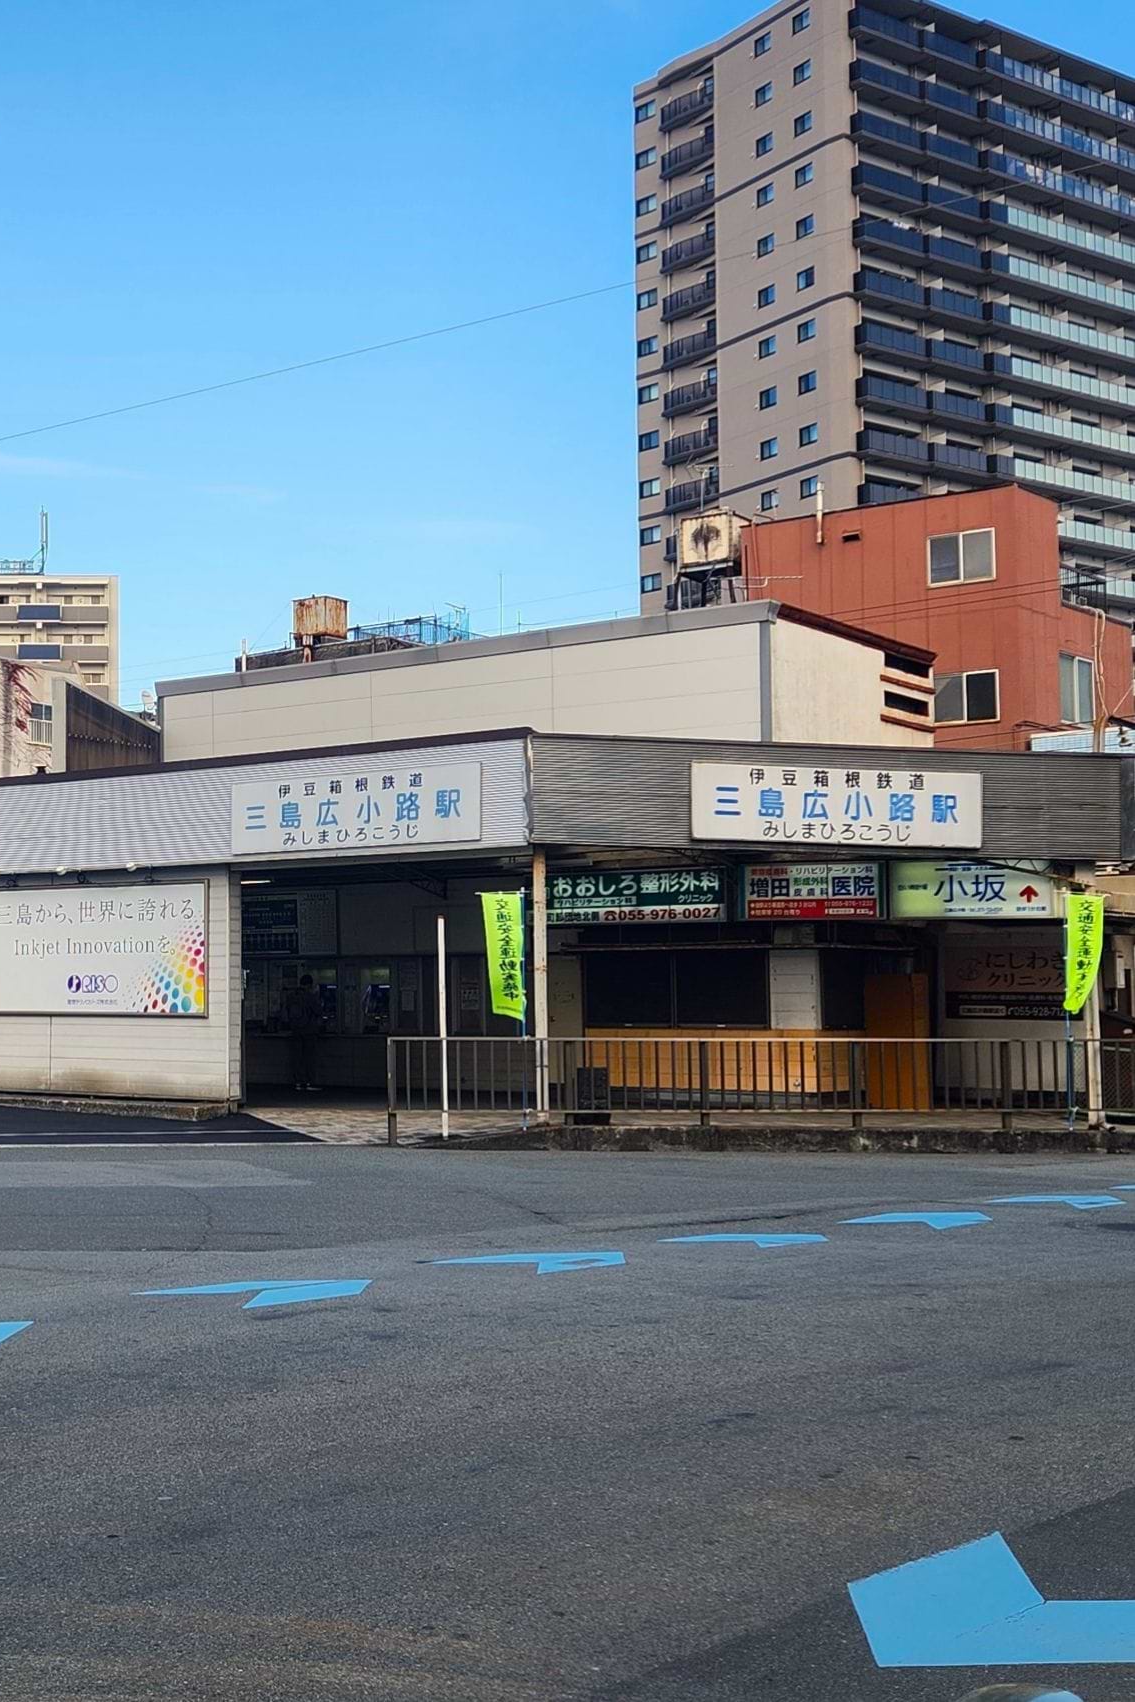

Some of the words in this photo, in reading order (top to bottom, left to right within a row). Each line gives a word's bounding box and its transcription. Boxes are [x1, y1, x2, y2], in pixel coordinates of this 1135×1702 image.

[278, 772, 423, 799] 伊豆箱根鉄道
[749, 768, 925, 791] 伊豆箱根鉄道
[245, 789, 461, 831] 三島広小路駅
[714, 786, 958, 824] 三島広小路駅
[282, 824, 419, 846] みしまひろこうじ
[762, 821, 912, 842] みしまひろこうじ
[553, 871, 720, 898] おおしろ整形外科
[749, 877, 790, 898] 増田
[831, 875, 875, 897] 医院
[934, 874, 1007, 903] 小坂
[677, 894, 714, 904] クリニック
[618, 907, 721, 922] 055-976-0027
[15, 938, 60, 959] Inkjet
[985, 951, 1064, 970] にしわき
[987, 973, 1064, 988] クリニック
[1014, 1006, 1065, 1017] 055-928-712
